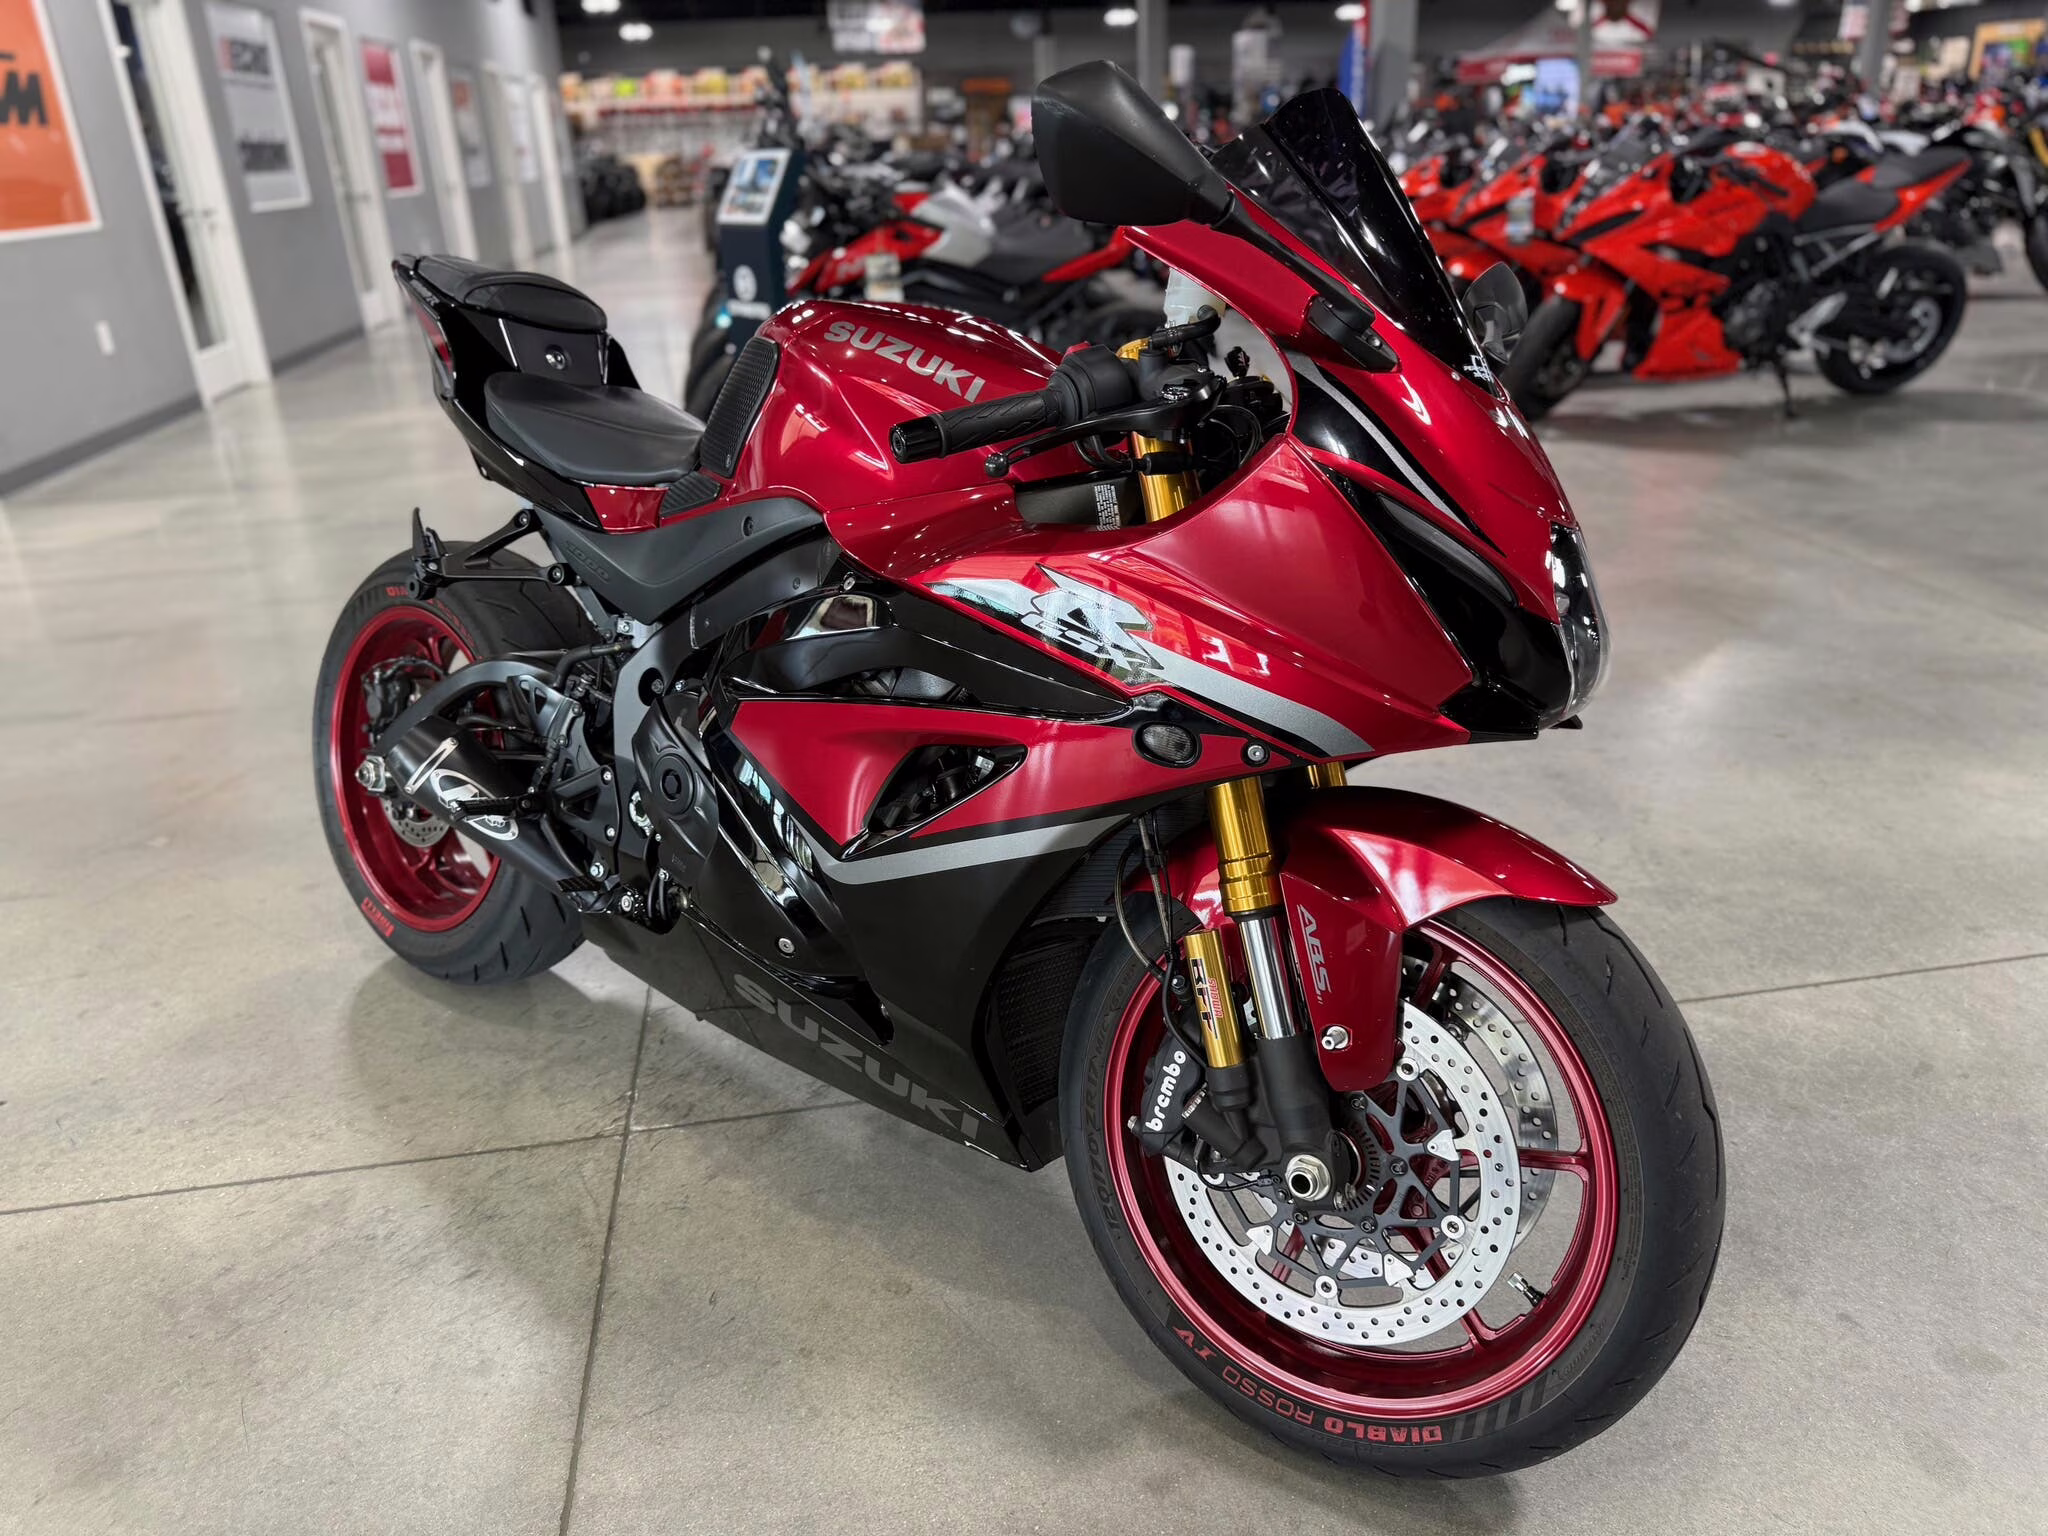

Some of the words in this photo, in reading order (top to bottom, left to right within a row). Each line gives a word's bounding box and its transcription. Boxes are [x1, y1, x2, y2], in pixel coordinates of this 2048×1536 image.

[824, 321, 986, 403] SUZUKI
[1297, 904, 1332, 997] ABS
[1207, 977, 1224, 1019] SHOWA
[733, 973, 979, 1140] SUZUKI
[1145, 1050, 1187, 1132] brembo
[1172, 1326, 1217, 1361] IV
[1222, 1365, 1315, 1425] ROSSO
[1324, 1416, 1443, 1443] DIABLO
